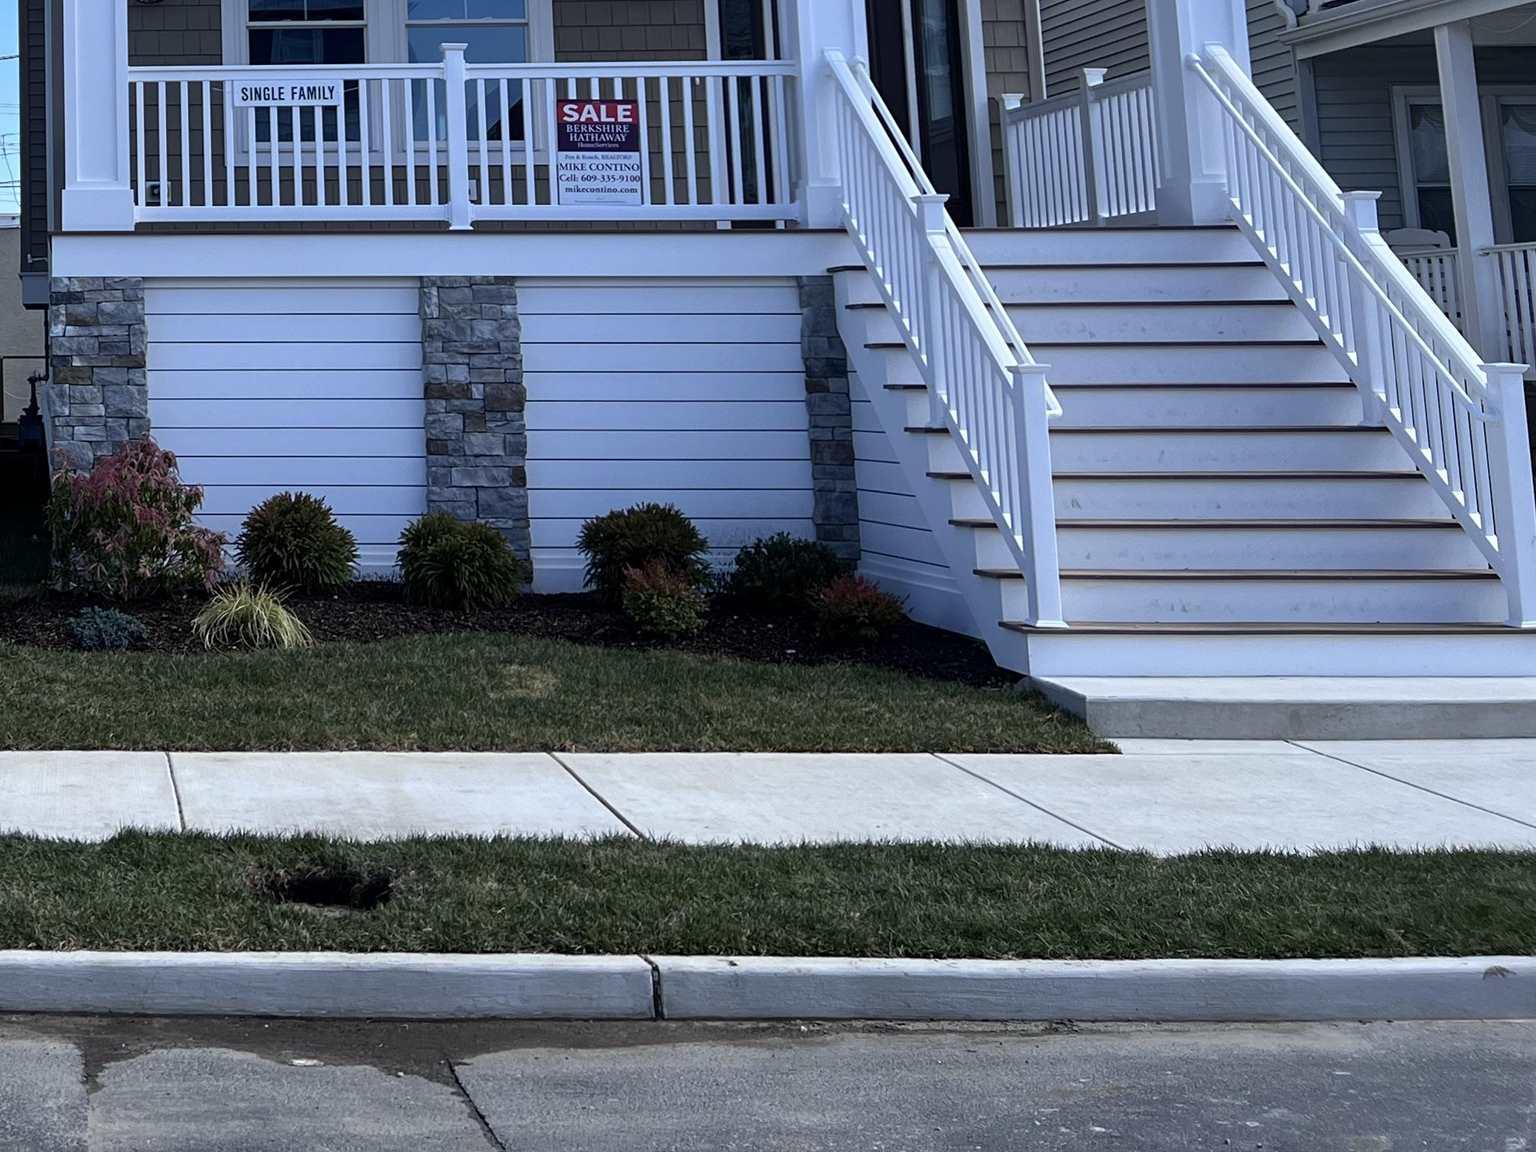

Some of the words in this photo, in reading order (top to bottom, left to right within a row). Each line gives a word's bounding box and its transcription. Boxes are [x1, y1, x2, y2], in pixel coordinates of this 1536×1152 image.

[241, 86, 285, 101] SINGLE
[291, 85, 335, 100] FAMILY
[562, 104, 633, 122] SALE
[566, 124, 630, 133] BERKSHIRE
[569, 133, 626, 142] HATHAWAY
[559, 163, 587, 171] MIKE
[589, 163, 640, 171] CONTINO
[581, 174, 641, 182] 609-335-9100
